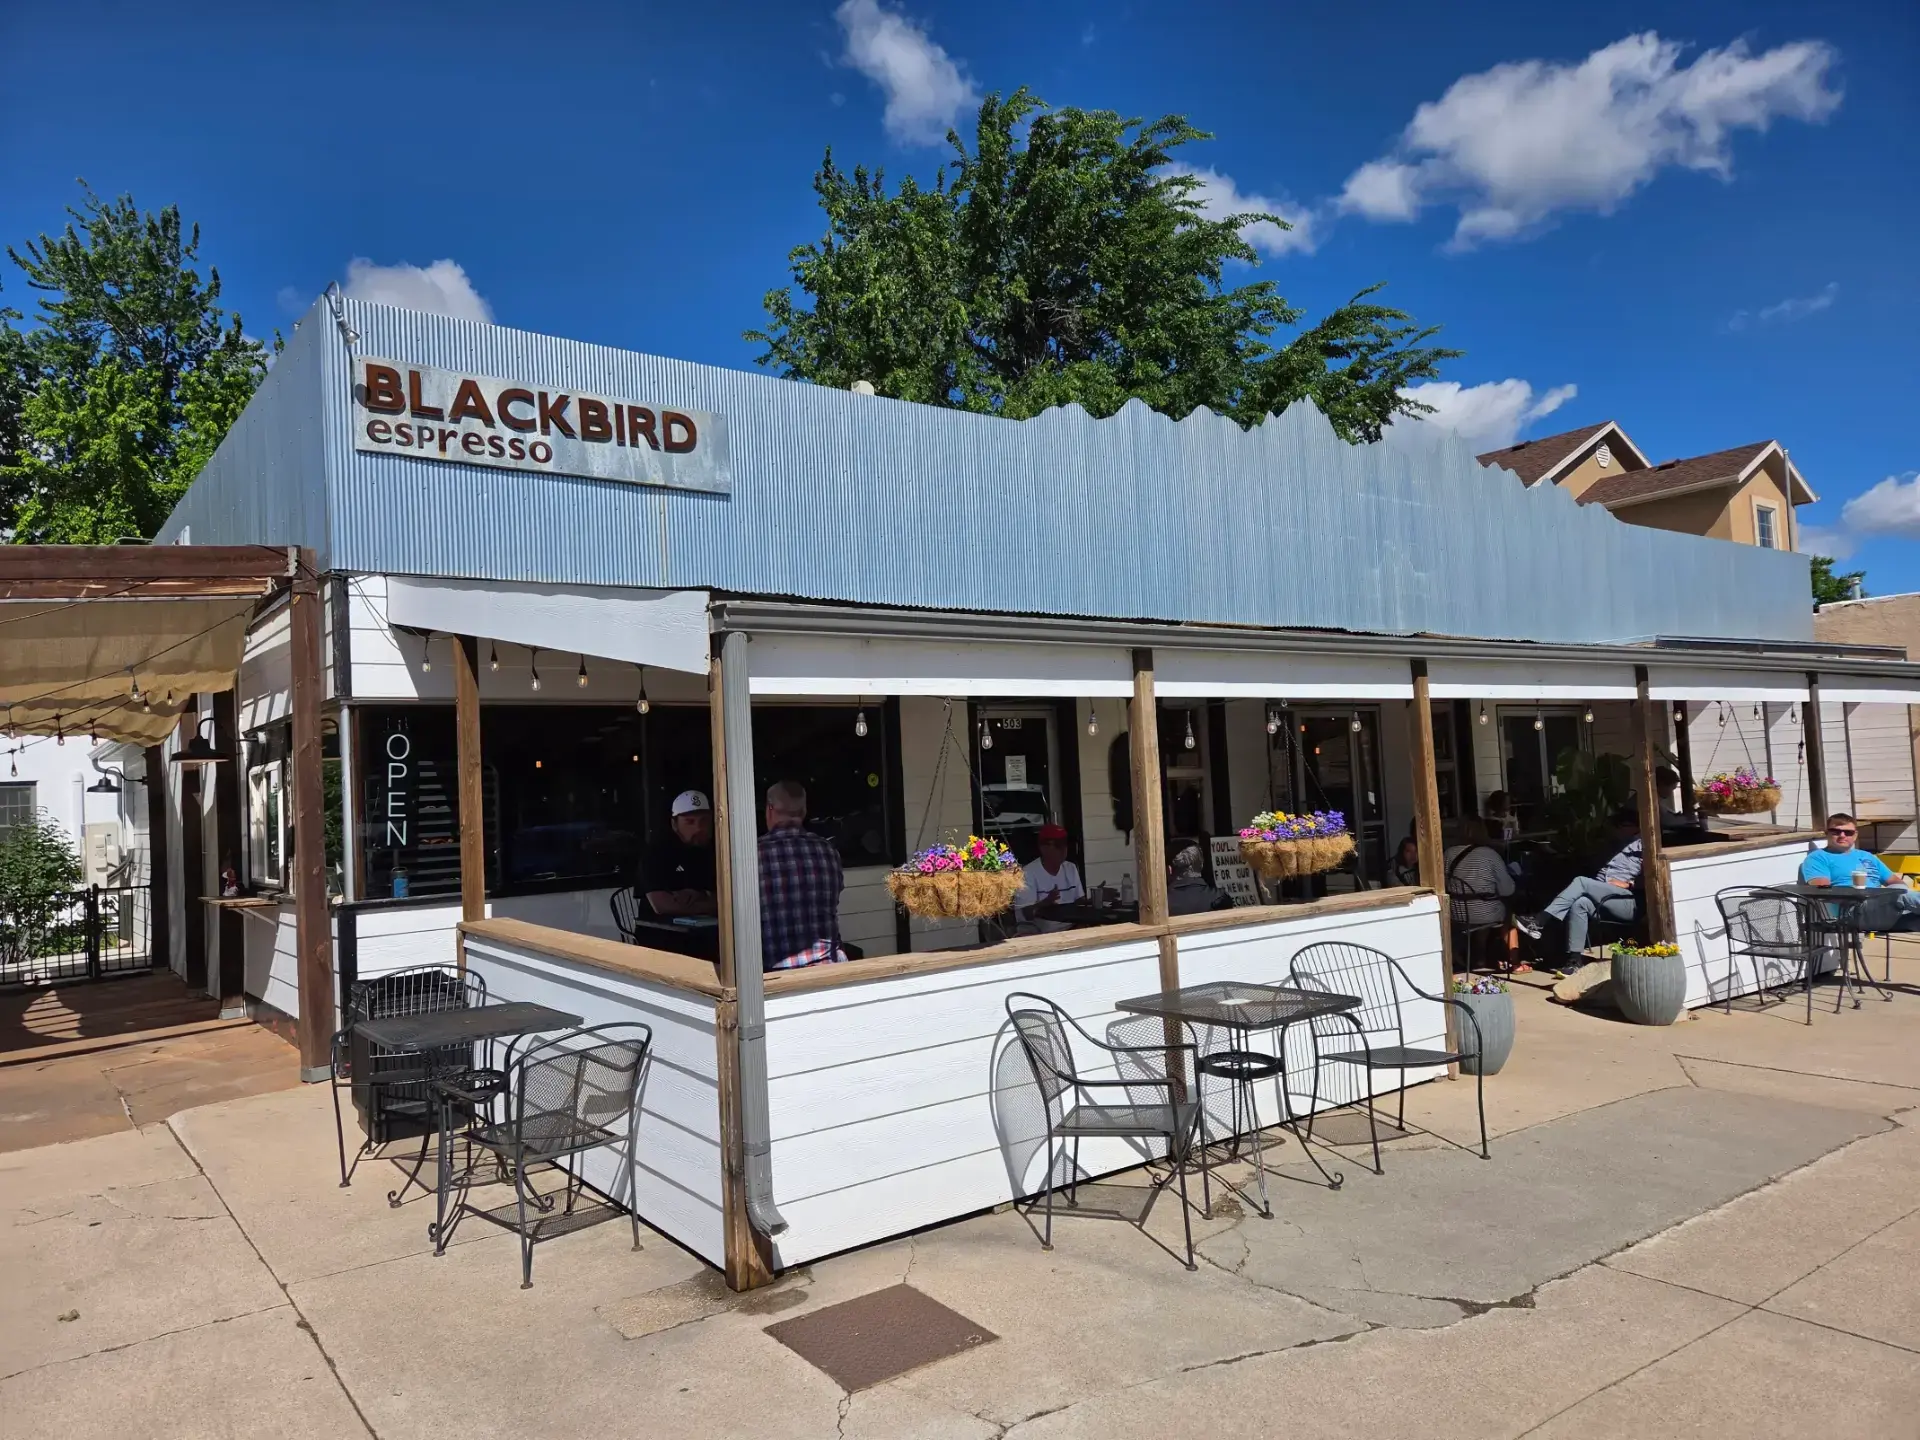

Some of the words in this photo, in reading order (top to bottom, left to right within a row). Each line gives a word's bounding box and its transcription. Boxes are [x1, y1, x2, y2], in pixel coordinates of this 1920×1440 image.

[365, 362, 698, 453] BLACKBIRD
[365, 418, 554, 464] espresso
[1004, 718, 1020, 728] 503
[386, 733, 410, 846] OPEN
[1214, 869, 1231, 880] FOR
[1236, 867, 1250, 878] OUR
